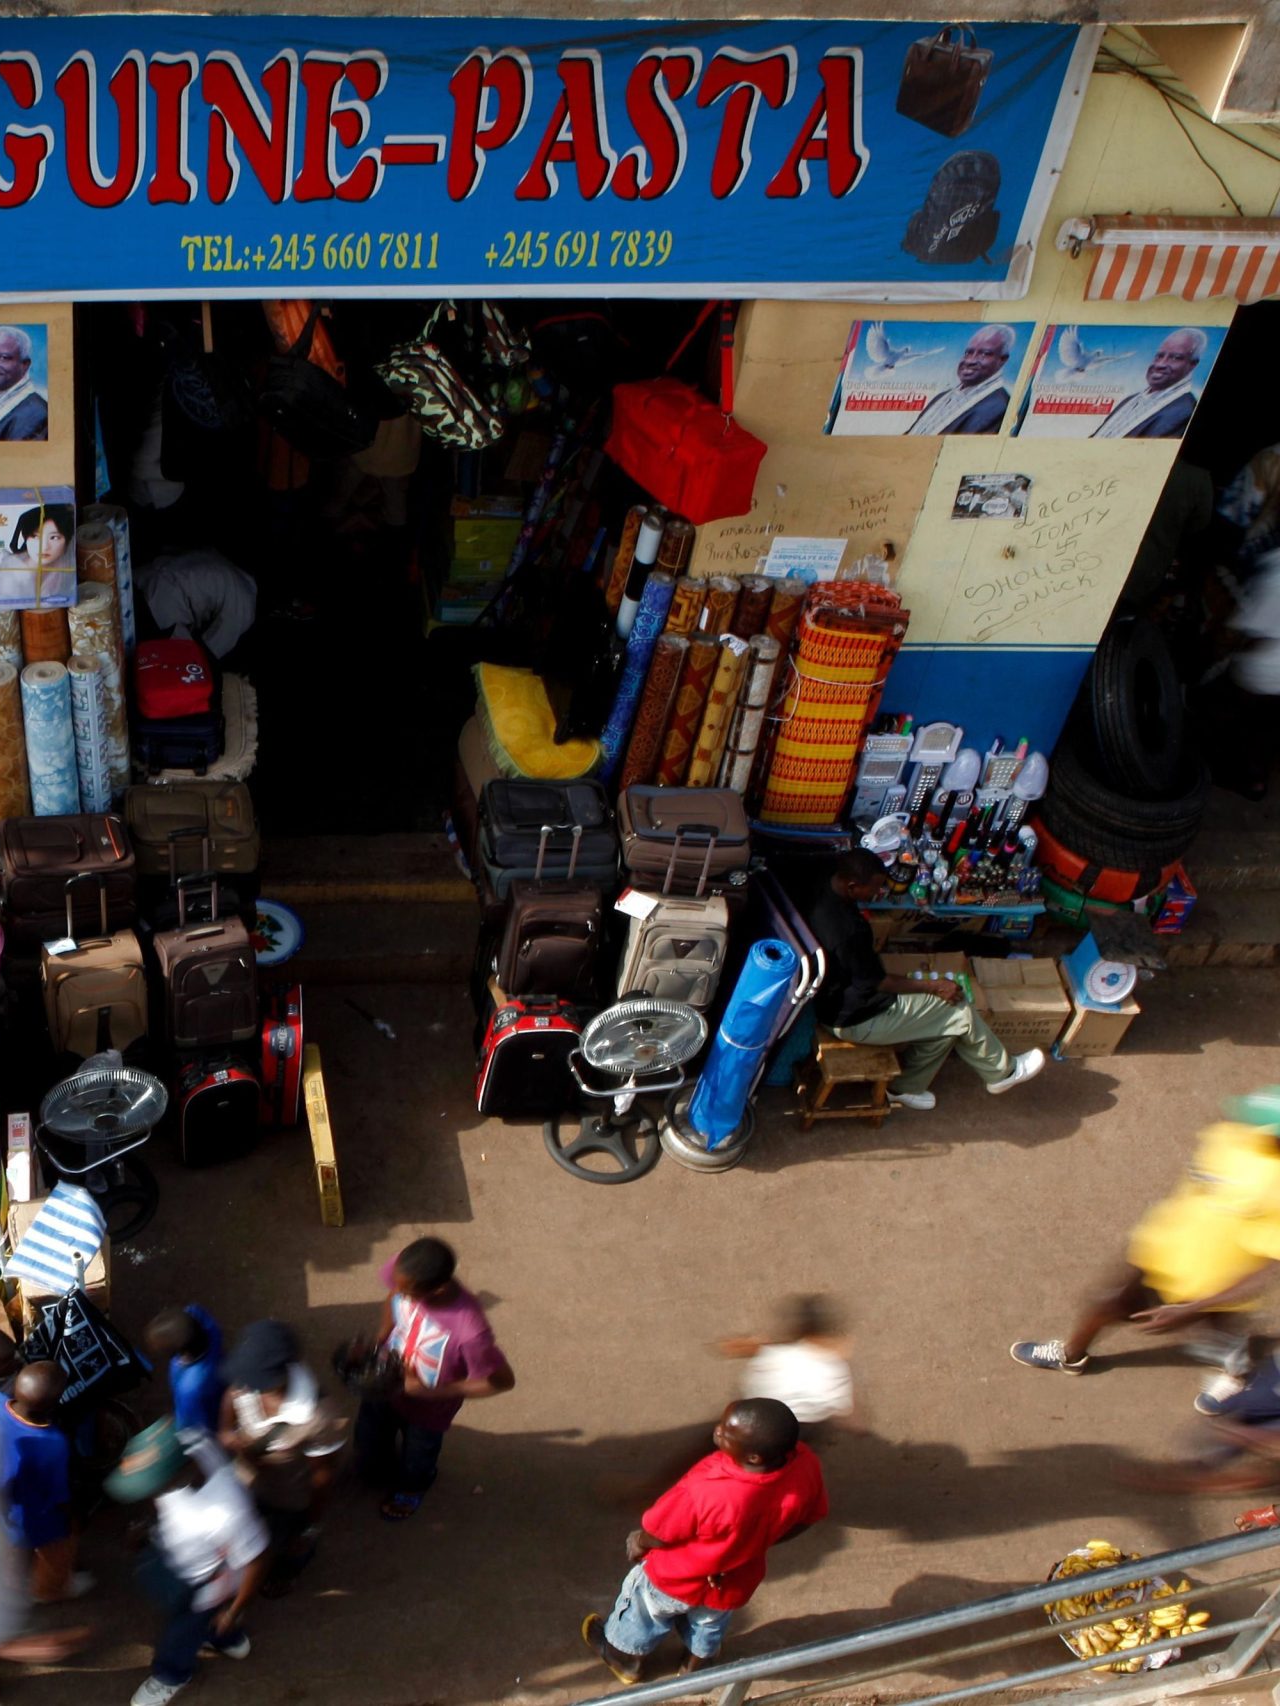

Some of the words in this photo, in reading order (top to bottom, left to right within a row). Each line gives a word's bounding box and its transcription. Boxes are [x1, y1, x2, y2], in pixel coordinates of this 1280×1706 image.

[322, 234, 371, 270] 660
[379, 232, 439, 270] 7811
[485, 231, 548, 268] +245
[554, 231, 601, 268] 691
[610, 230, 674, 267] 7839
